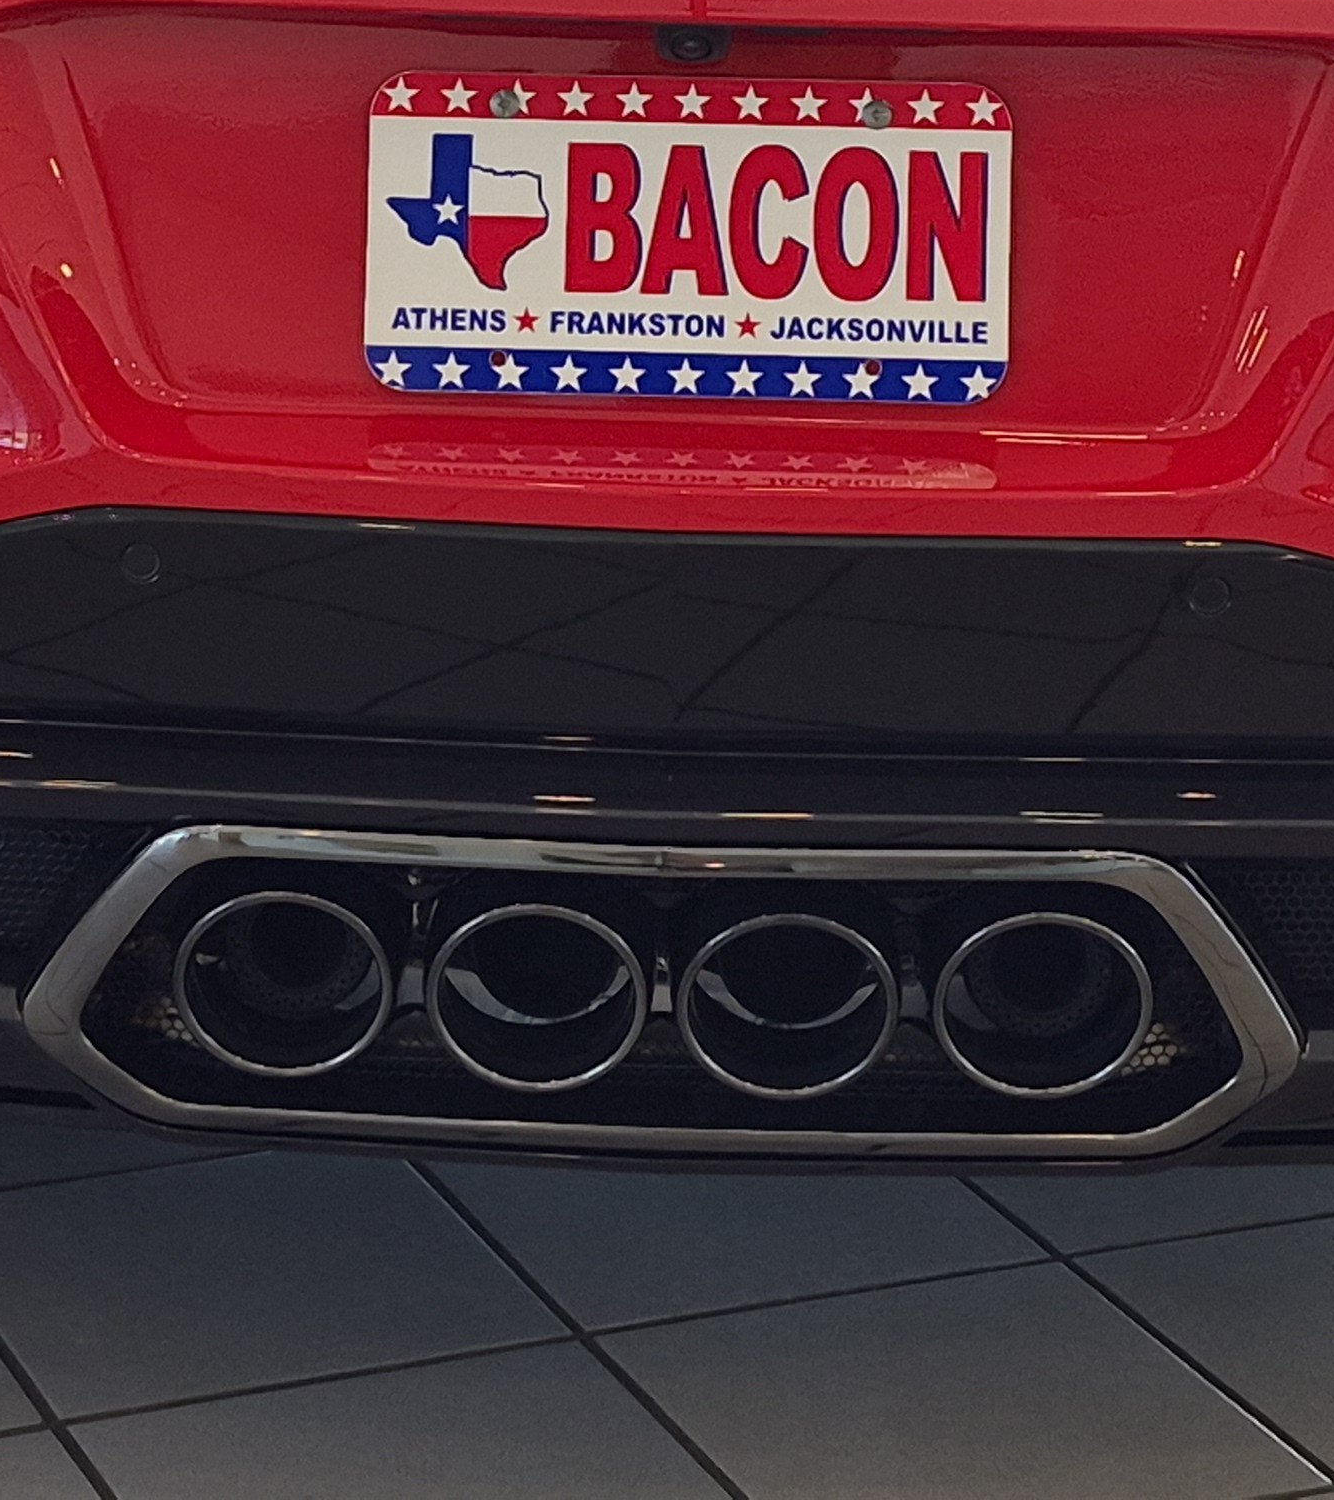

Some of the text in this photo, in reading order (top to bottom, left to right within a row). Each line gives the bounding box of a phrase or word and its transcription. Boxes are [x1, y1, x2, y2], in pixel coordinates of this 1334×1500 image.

[565, 141, 988, 302] BACON
[391, 307, 989, 344] ATHENS FRANKSTON JACKSONVILLE
